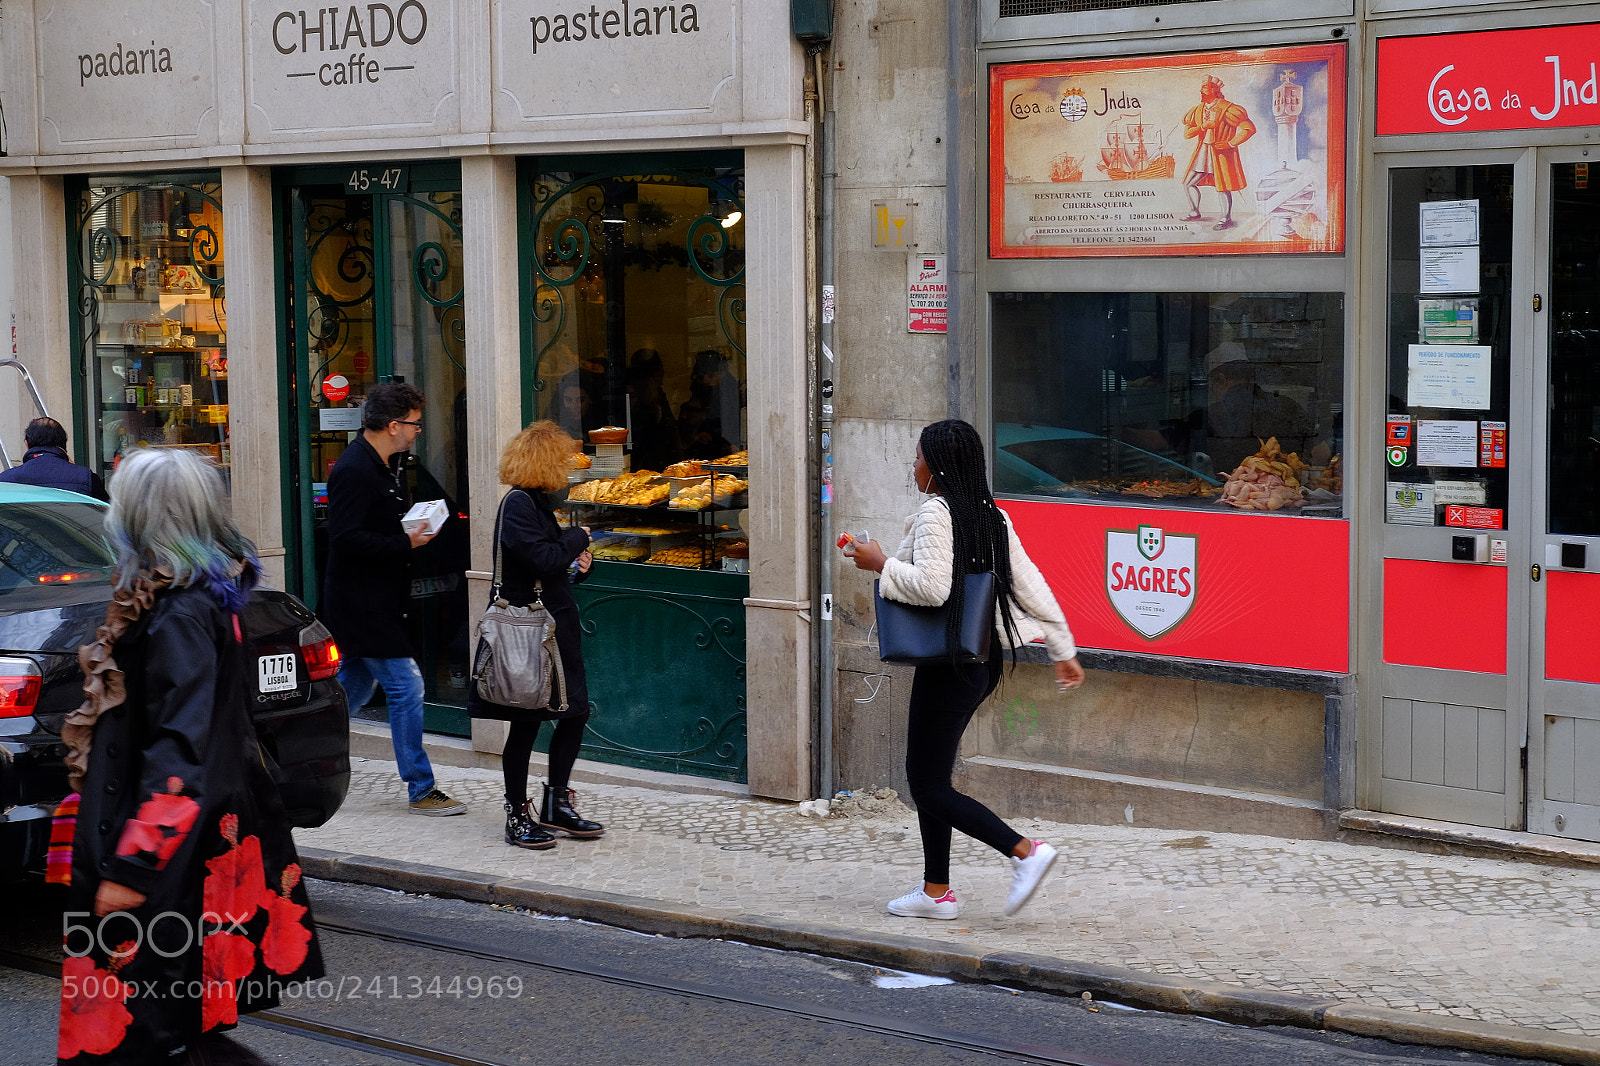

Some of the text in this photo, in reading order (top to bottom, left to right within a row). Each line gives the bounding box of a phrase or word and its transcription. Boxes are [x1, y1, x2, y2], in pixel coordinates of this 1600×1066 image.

[272, 0, 427, 55] CHIADO
[529, 0, 700, 54] pastelaria
[78, 40, 173, 87] padaria
[318, 52, 380, 87] caffe
[1010, 93, 1041, 120] Casa
[1045, 104, 1056, 113] da
[1427, 64, 1492, 125] Casa
[1500, 90, 1521, 110] da
[348, 168, 401, 191] 45-47
[1034, 190, 1156, 200] RESTAURANTE CERVEJARIA
[1062, 201, 1134, 210] CHURRASQUEIRA
[1111, 562, 1191, 597] SAGRES
[261, 656, 293, 675] 1776
[267, 675, 288, 685] LISBOA
